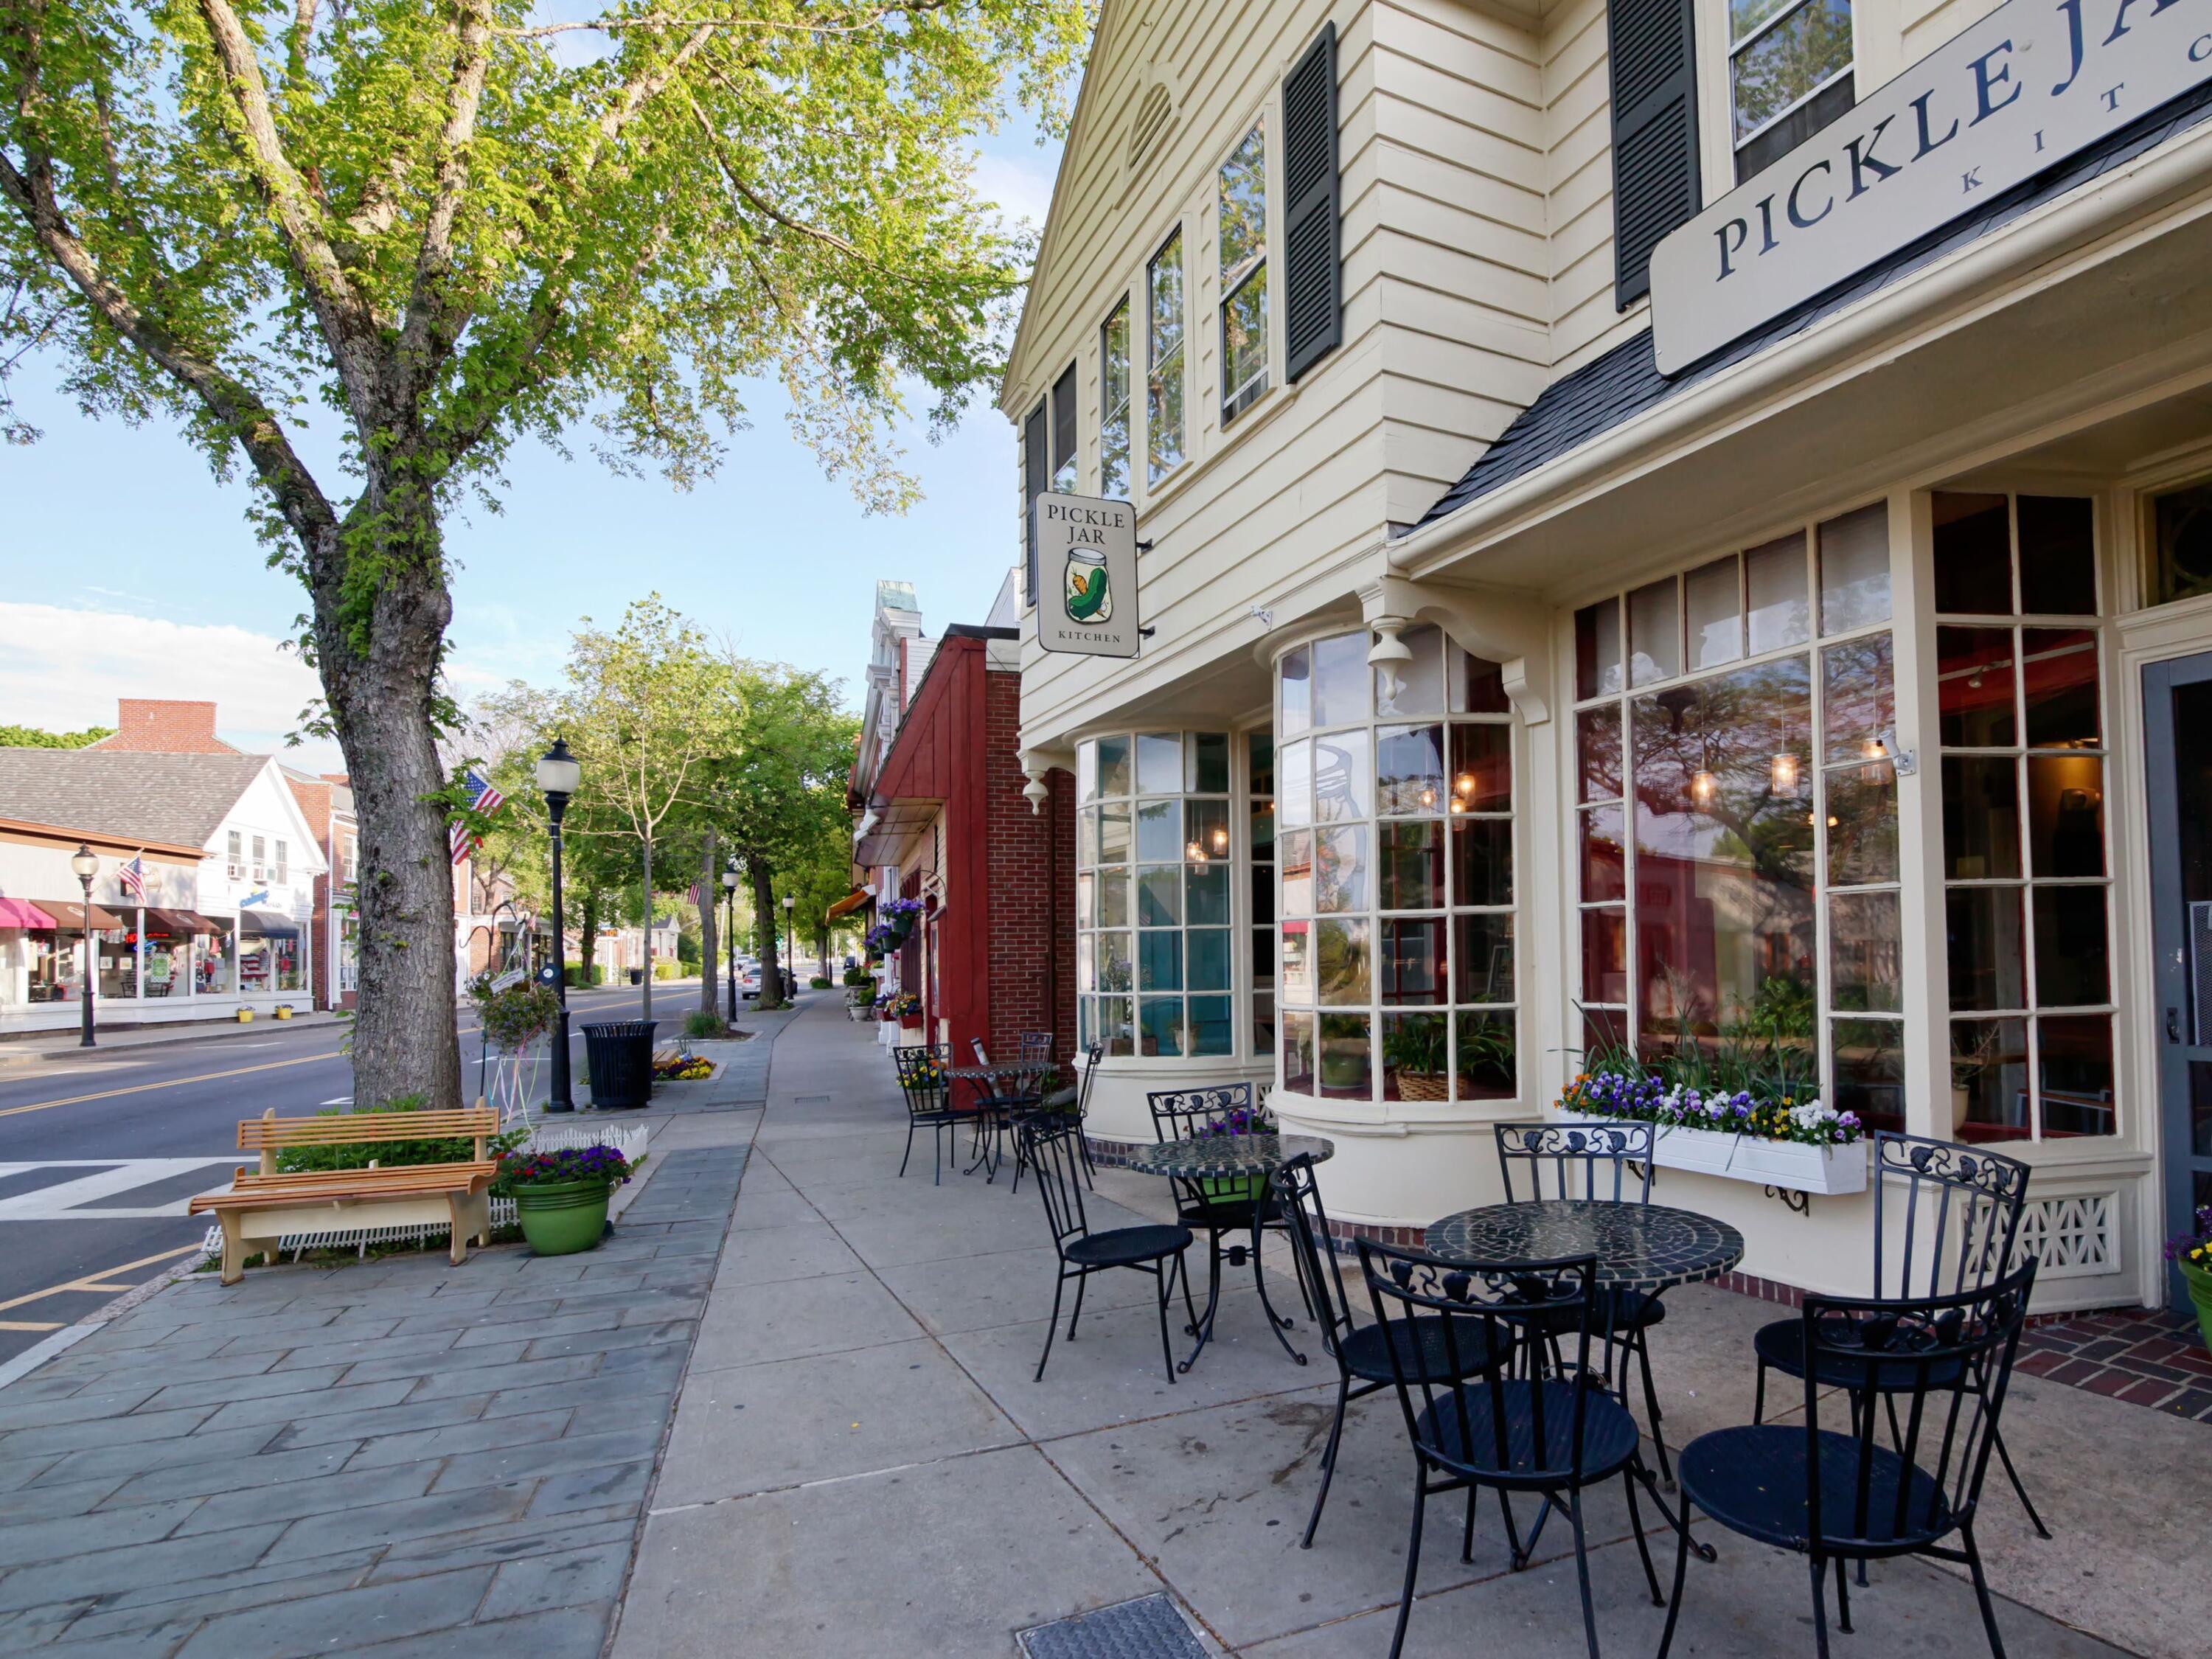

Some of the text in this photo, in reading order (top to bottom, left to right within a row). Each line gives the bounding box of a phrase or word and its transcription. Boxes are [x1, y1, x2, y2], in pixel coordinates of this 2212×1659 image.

[1715, 40, 2022, 282] PICKLE
[1048, 504, 1125, 528] PICKLE
[1068, 526, 1105, 544] JAR
[1058, 630, 1121, 643] KITCHEN
